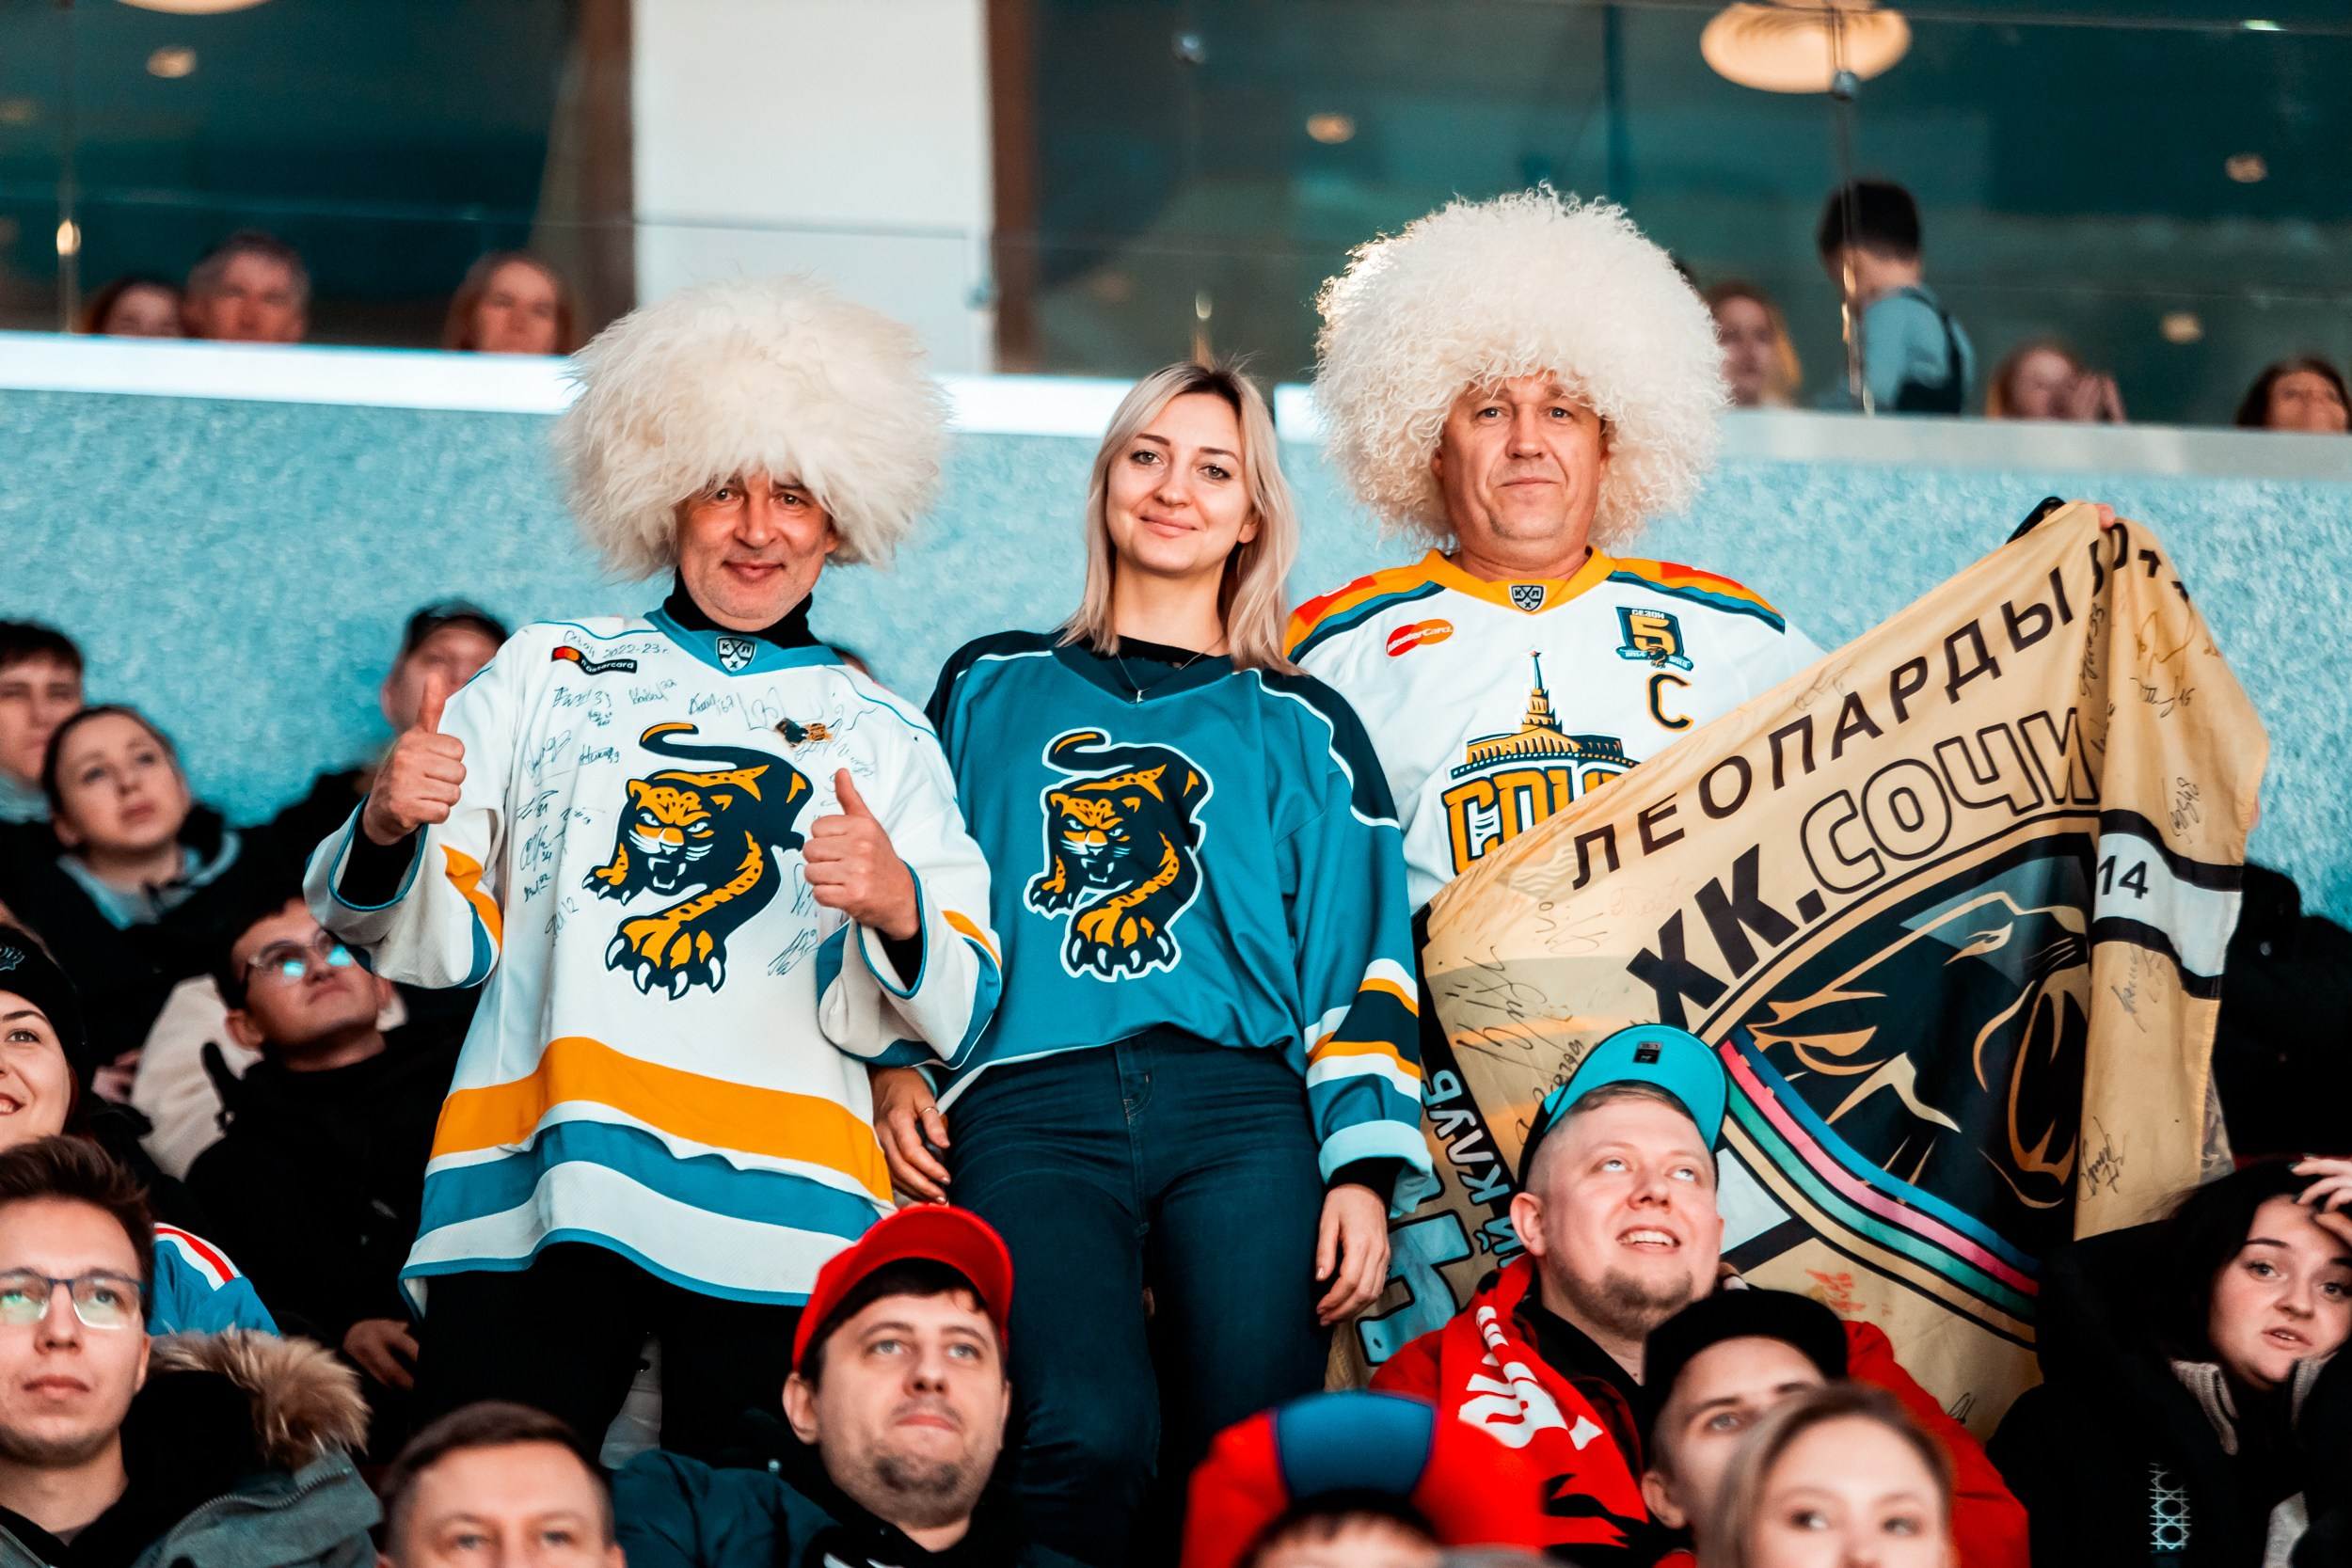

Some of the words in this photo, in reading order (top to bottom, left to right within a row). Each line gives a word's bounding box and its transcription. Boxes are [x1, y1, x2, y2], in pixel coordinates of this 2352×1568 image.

[1387, 626, 1454, 654] MasterCard
[1629, 614, 1676, 656] 5
[1572, 566, 2074, 890] ЛЕОПАРДЫ
[2097, 855, 2149, 899] 14
[1422, 1069, 1511, 1204] КЛУБ
